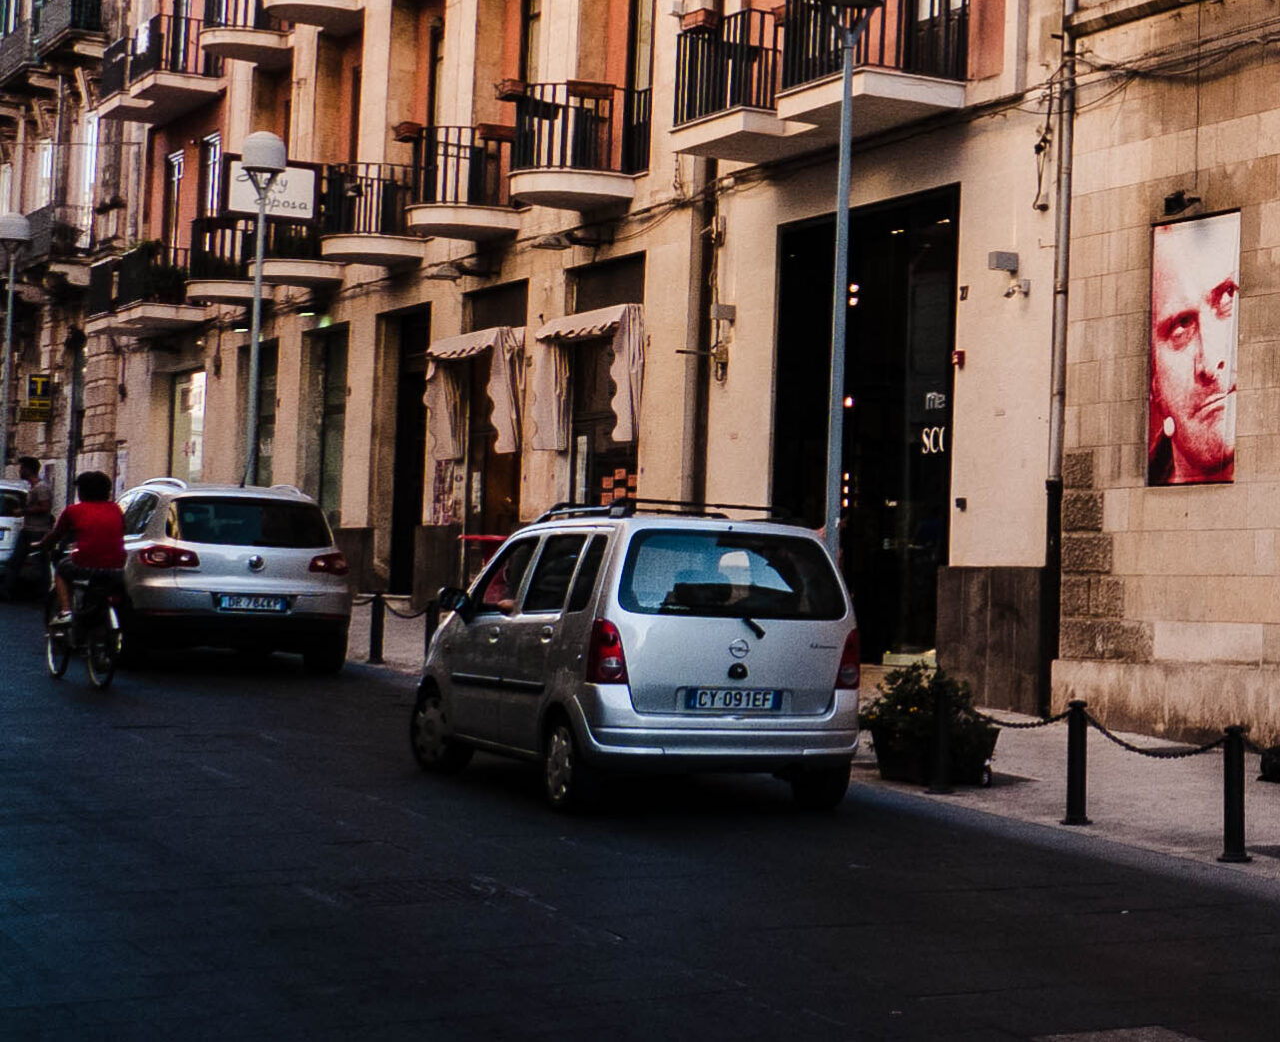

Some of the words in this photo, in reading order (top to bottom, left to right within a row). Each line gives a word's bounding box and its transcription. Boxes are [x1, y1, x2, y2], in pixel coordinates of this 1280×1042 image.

[31, 377, 49, 395] T
[698, 691, 718, 707] CY
[723, 691, 771, 707] 091EF
